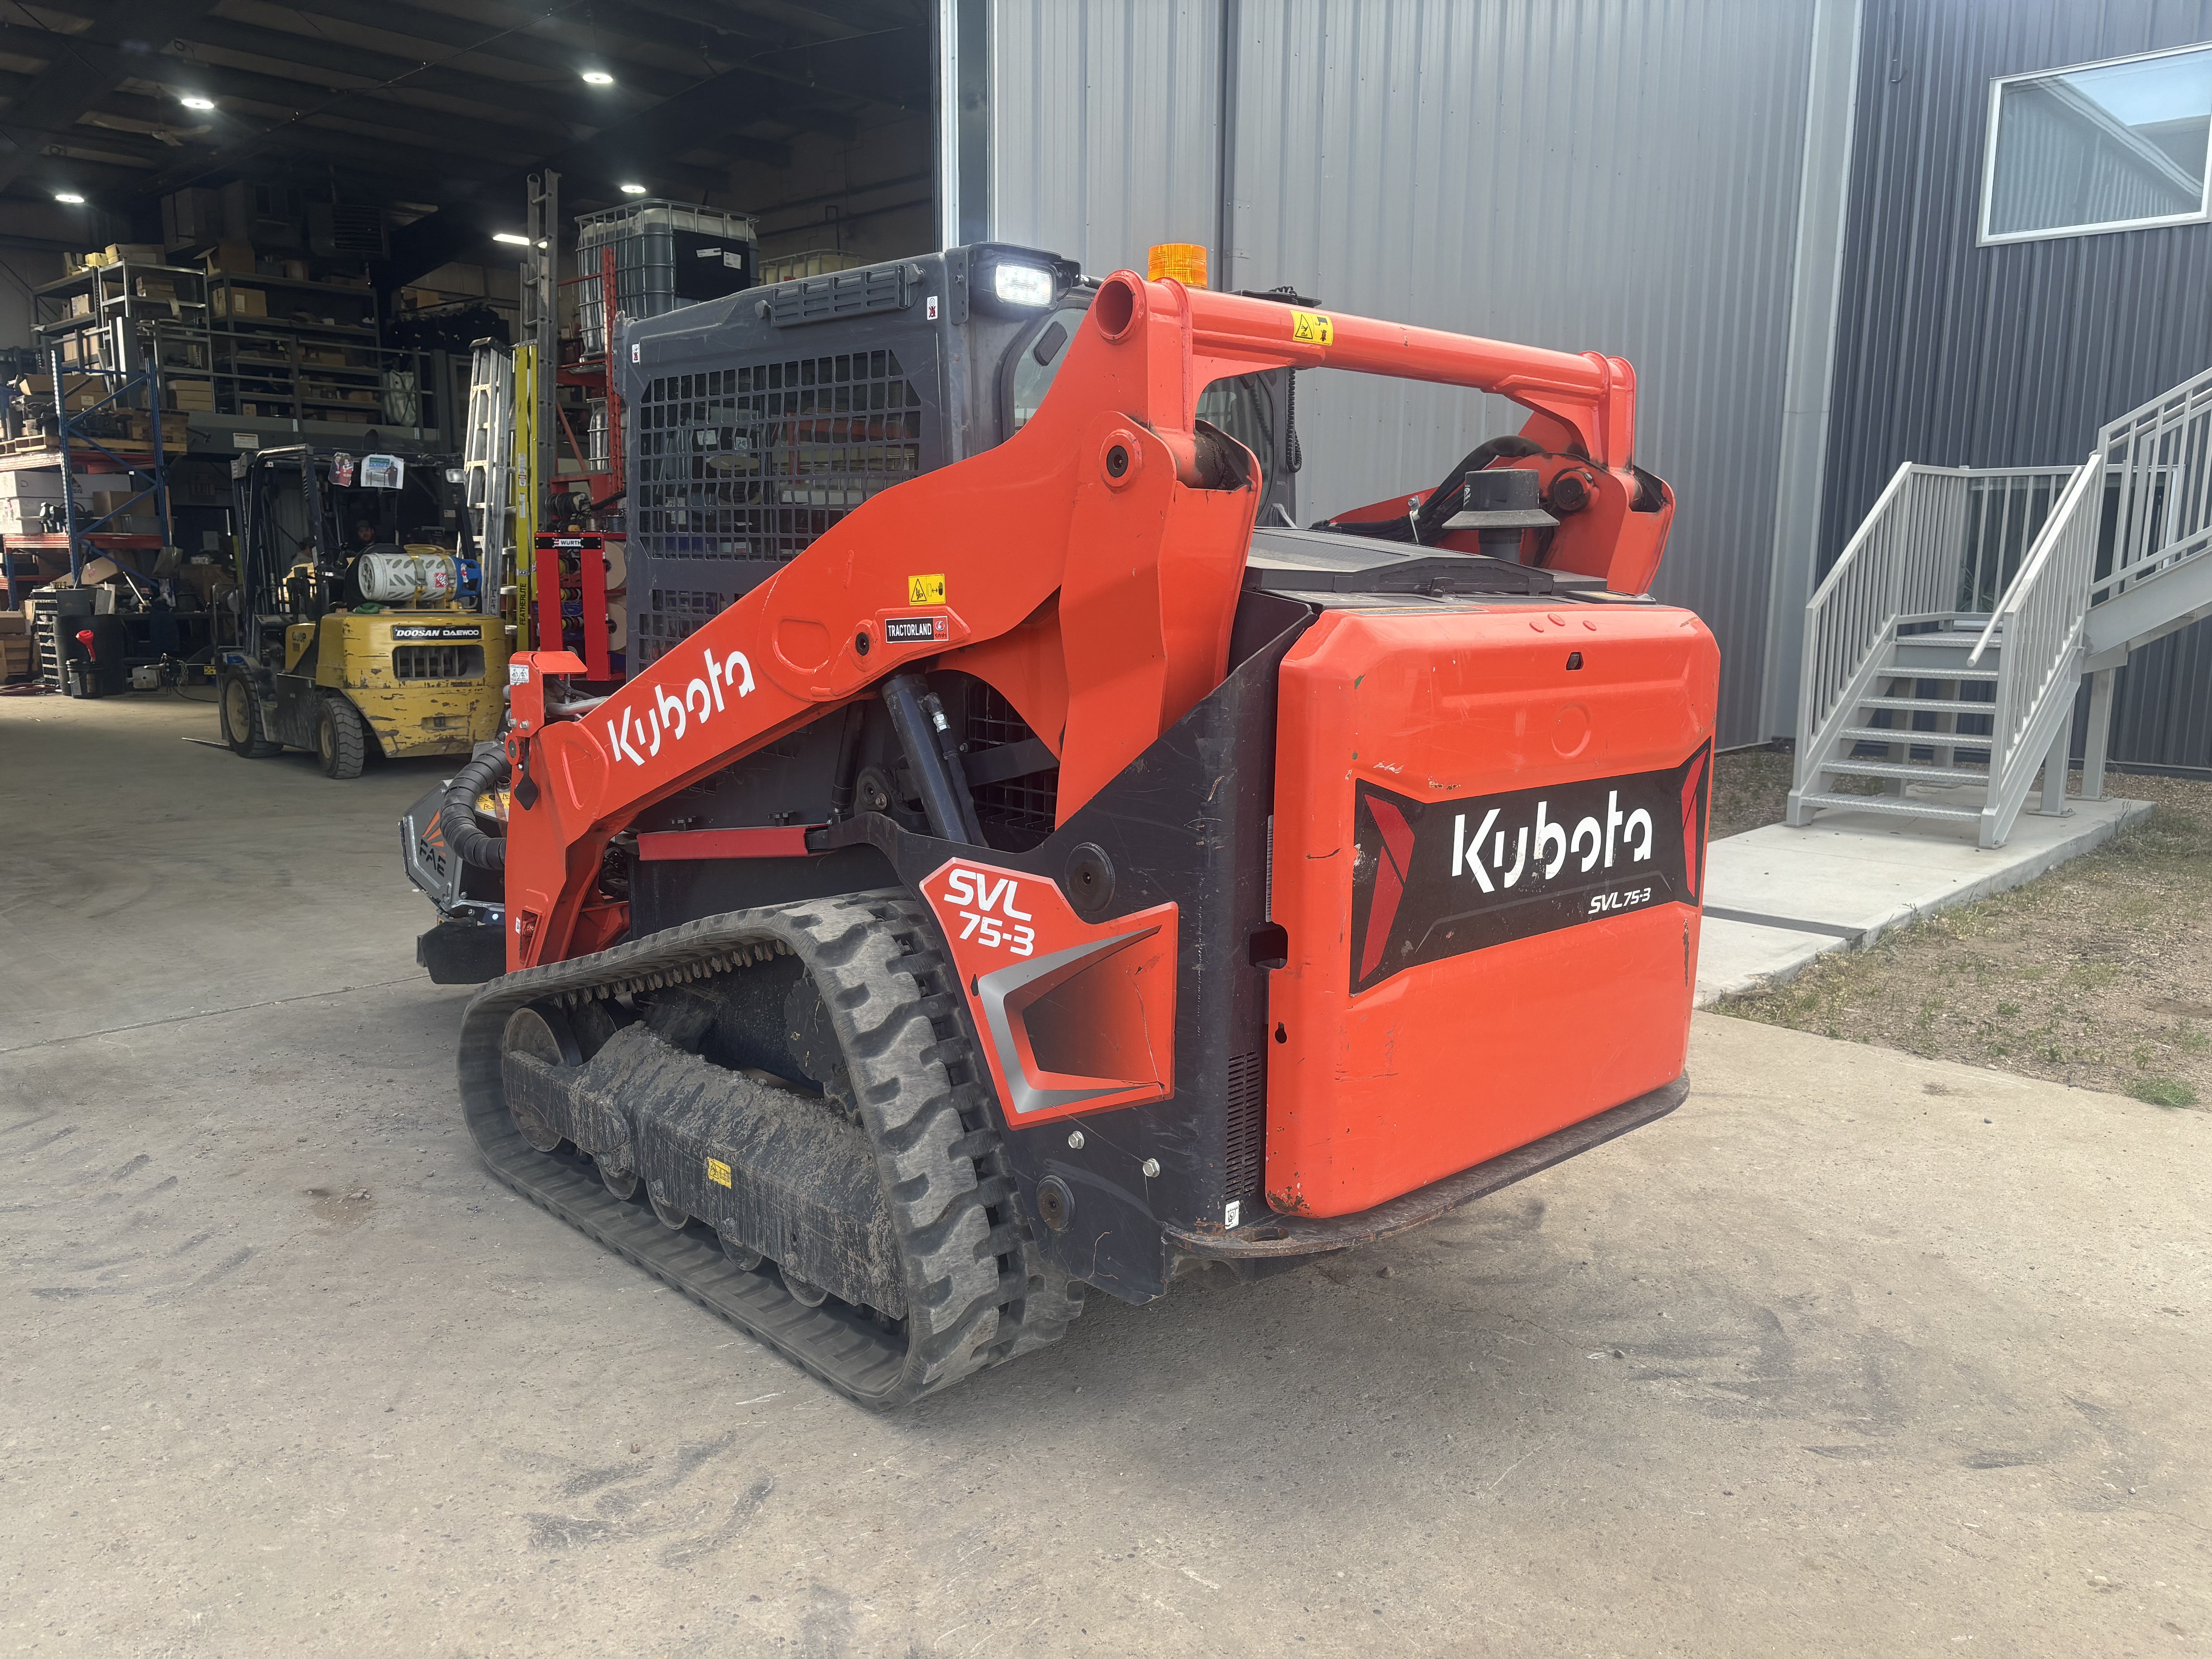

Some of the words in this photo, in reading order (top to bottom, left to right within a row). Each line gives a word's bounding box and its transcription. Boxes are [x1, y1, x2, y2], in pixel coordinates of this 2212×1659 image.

[437, 574, 448, 586] 1075
[888, 623, 932, 637] TRACTORLAND
[607, 648, 755, 766] Kubota
[419, 838, 446, 878] FAE
[1452, 790, 1652, 893] Kubota
[944, 869, 1032, 922] SVL
[959, 911, 1035, 956] 75-3
